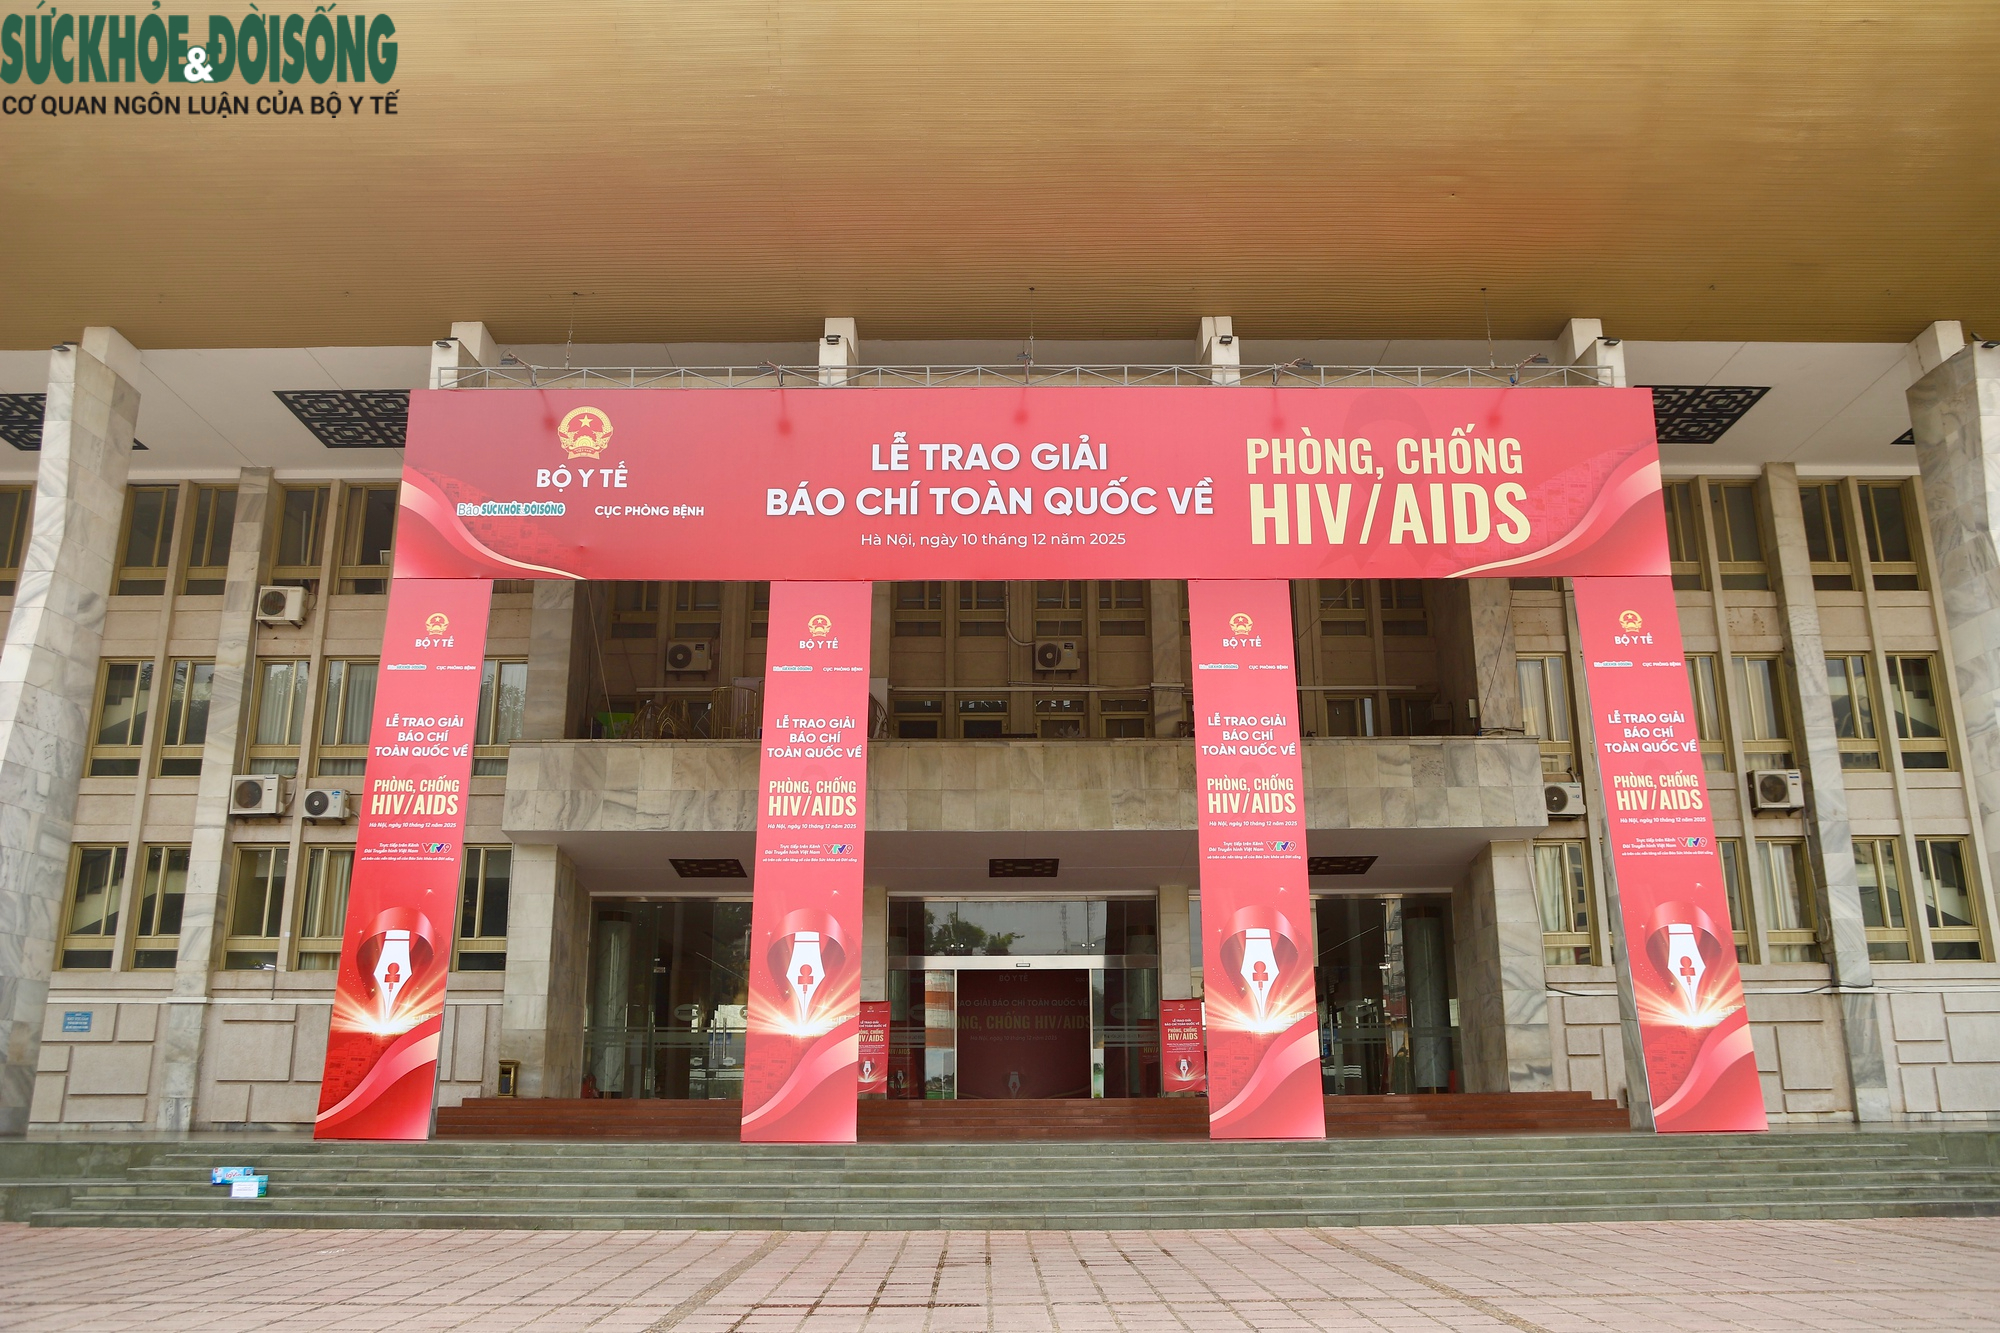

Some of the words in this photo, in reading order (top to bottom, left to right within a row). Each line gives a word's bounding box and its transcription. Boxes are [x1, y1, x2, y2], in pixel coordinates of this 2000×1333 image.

[871, 432, 909, 471] LỄ
[920, 442, 1020, 471] TRAO
[1031, 434, 1107, 471] GIẢI
[1246, 427, 1384, 480] PHÒNG,
[1396, 424, 1522, 475] CHỐNG
[536, 464, 572, 492] BỘ
[578, 469, 595, 488] Y
[600, 460, 628, 488] TẾ
[767, 481, 845, 516] BÁO
[856, 480, 920, 516] CHÍ
[929, 480, 1031, 516] TOÀN
[1043, 477, 1157, 516] QUỐC
[1167, 477, 1213, 516] VỀ
[595, 506, 621, 518] CỤC
[625, 504, 669, 516] PHÒNG
[673, 504, 704, 518] BỆNH
[1249, 481, 1531, 544] HIV/AIDS
[861, 532, 881, 546] Hà
[887, 533, 916, 548] Nội,
[920, 534, 957, 549] ngày
[962, 534, 977, 546] 10
[981, 533, 1028, 549] tháng
[1032, 534, 1046, 546] 12
[1051, 533, 1085, 546] năm
[1090, 533, 1126, 546] 2025
[415, 637, 430, 649] BỘ
[433, 639, 440, 647] Y
[442, 636, 454, 647] TẾ
[800, 639, 814, 650] BỘ
[826, 637, 838, 648] TẾ
[1223, 637, 1238, 648] BỘ
[1240, 639, 1247, 647] Y
[1249, 636, 1261, 647] TẾ
[1615, 634, 1630, 646] BỘ
[1632, 636, 1638, 644] Y
[1640, 633, 1653, 644] TẾ
[386, 714, 399, 727] LỄ
[402, 717, 435, 727] TRAO
[438, 715, 464, 727] GIẢI
[776, 715, 789, 728] LỄ
[793, 719, 826, 728] TRAO
[829, 716, 855, 728] GIẢI
[1208, 713, 1220, 726] LỄ
[1224, 716, 1257, 726] TRAO
[1261, 714, 1286, 726] GIẢI
[1608, 710, 1621, 723] LỄ
[1623, 714, 1656, 723] TRAO
[1659, 711, 1684, 723] GIẢI
[398, 730, 424, 741] BÁO
[427, 730, 449, 741] CHÍ
[790, 731, 816, 742] BÁO
[820, 731, 841, 742] CHÍ
[1223, 729, 1249, 740] BÁO
[1252, 729, 1273, 740] CHÍ
[1624, 726, 1650, 738] BÁO
[1653, 726, 1673, 738] CHÍ
[375, 745, 408, 756] TOÀN
[412, 744, 449, 756] QUỐC
[767, 746, 801, 757] TOÀN
[805, 745, 842, 758] QUỐC
[1202, 743, 1236, 755] TOÀN
[1239, 742, 1277, 756] QUỐC
[1605, 741, 1639, 752] TOÀN
[1642, 739, 1678, 752] QUỐC
[374, 776, 416, 793] PHÒNG,
[420, 775, 459, 792] CHỐNG
[769, 777, 812, 794] PHÒNG,
[816, 776, 856, 793] CHỐNG
[1207, 775, 1250, 792] PHÒNG,
[1254, 774, 1293, 790] CHỐNG
[1614, 772, 1657, 789] PHÒNG,
[1659, 770, 1698, 787] CHỐNG
[371, 794, 458, 815] HIV/AIDS
[769, 795, 856, 816] HIV/AIDS
[1208, 793, 1296, 814] HIV/AIDS
[1616, 789, 1703, 810] HIV/AIDS
[859, 1034, 884, 1042] IV/AIDS
